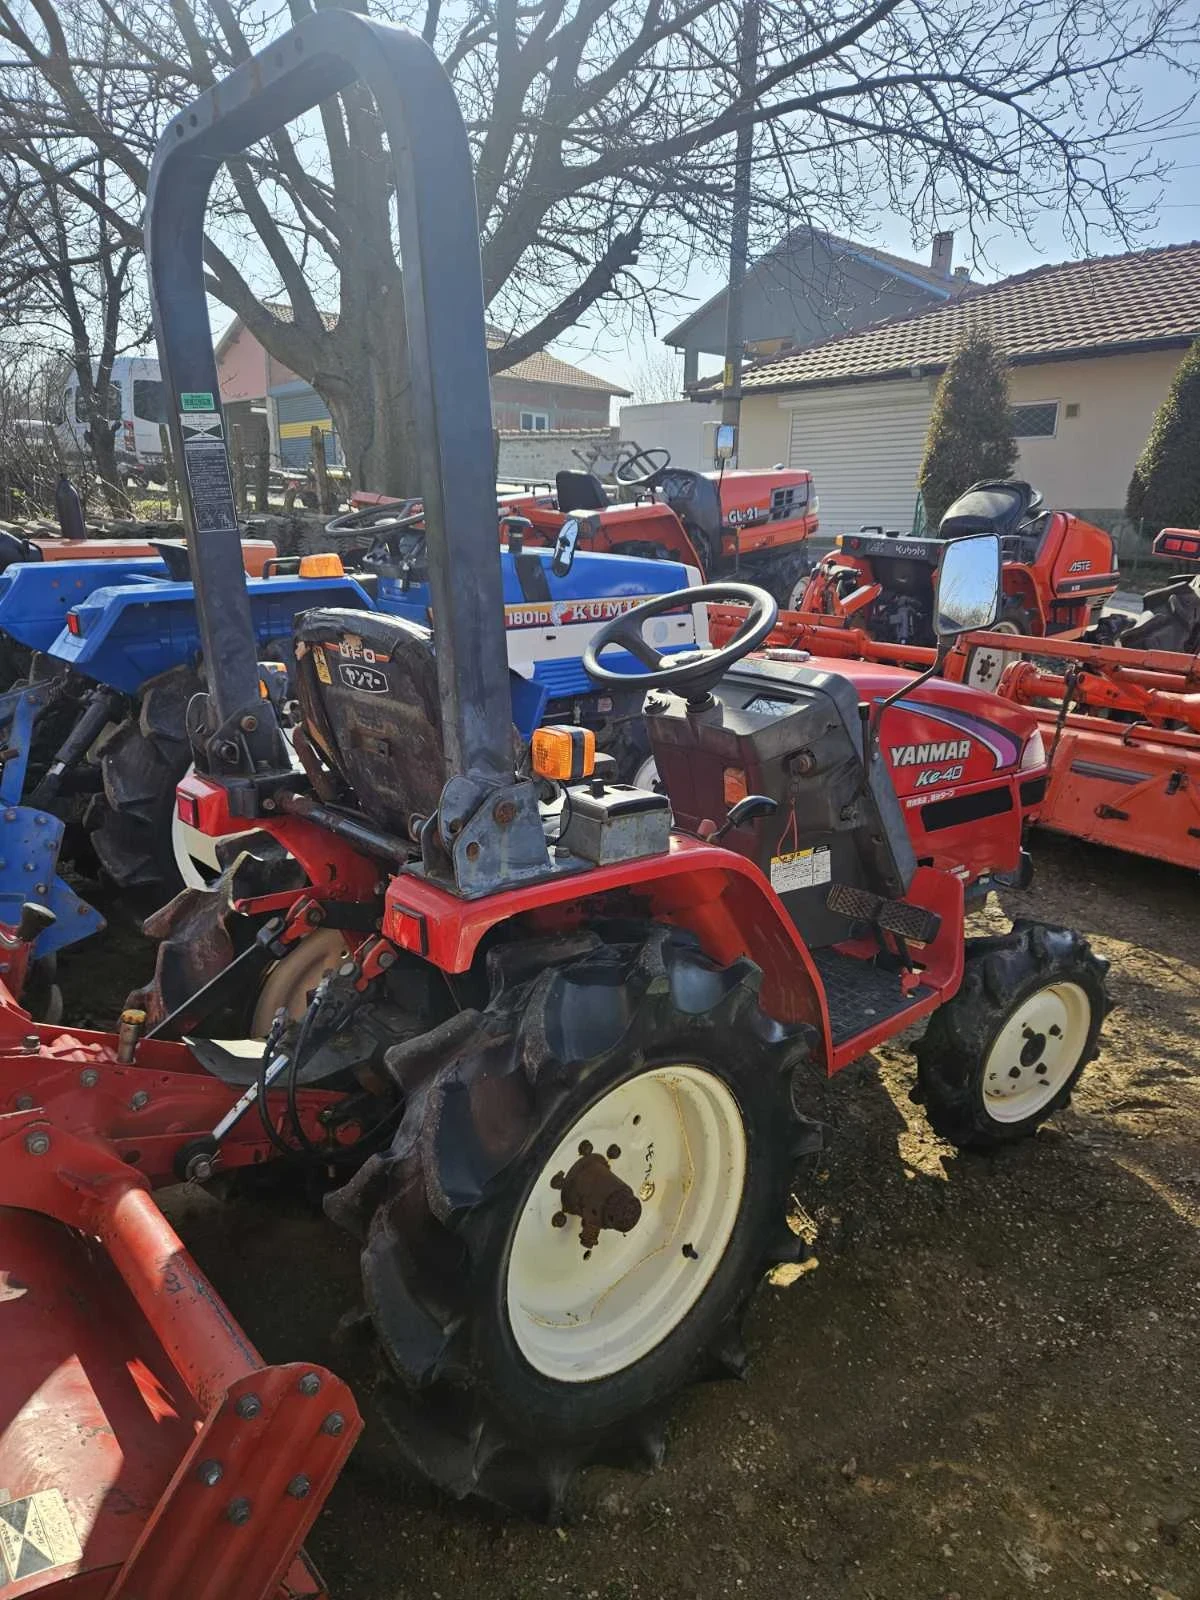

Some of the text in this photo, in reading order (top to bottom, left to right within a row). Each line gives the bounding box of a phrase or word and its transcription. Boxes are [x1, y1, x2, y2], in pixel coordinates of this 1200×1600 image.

[728, 507, 758, 524] GL-21
[895, 544, 926, 556] Kubota
[509, 611, 548, 625] 1801D
[572, 600, 647, 620] KUMI
[339, 640, 376, 664] UFO
[345, 667, 381, 689] ヤンマー
[891, 740, 971, 767] YANMAR
[914, 765, 963, 787] Ke-40
